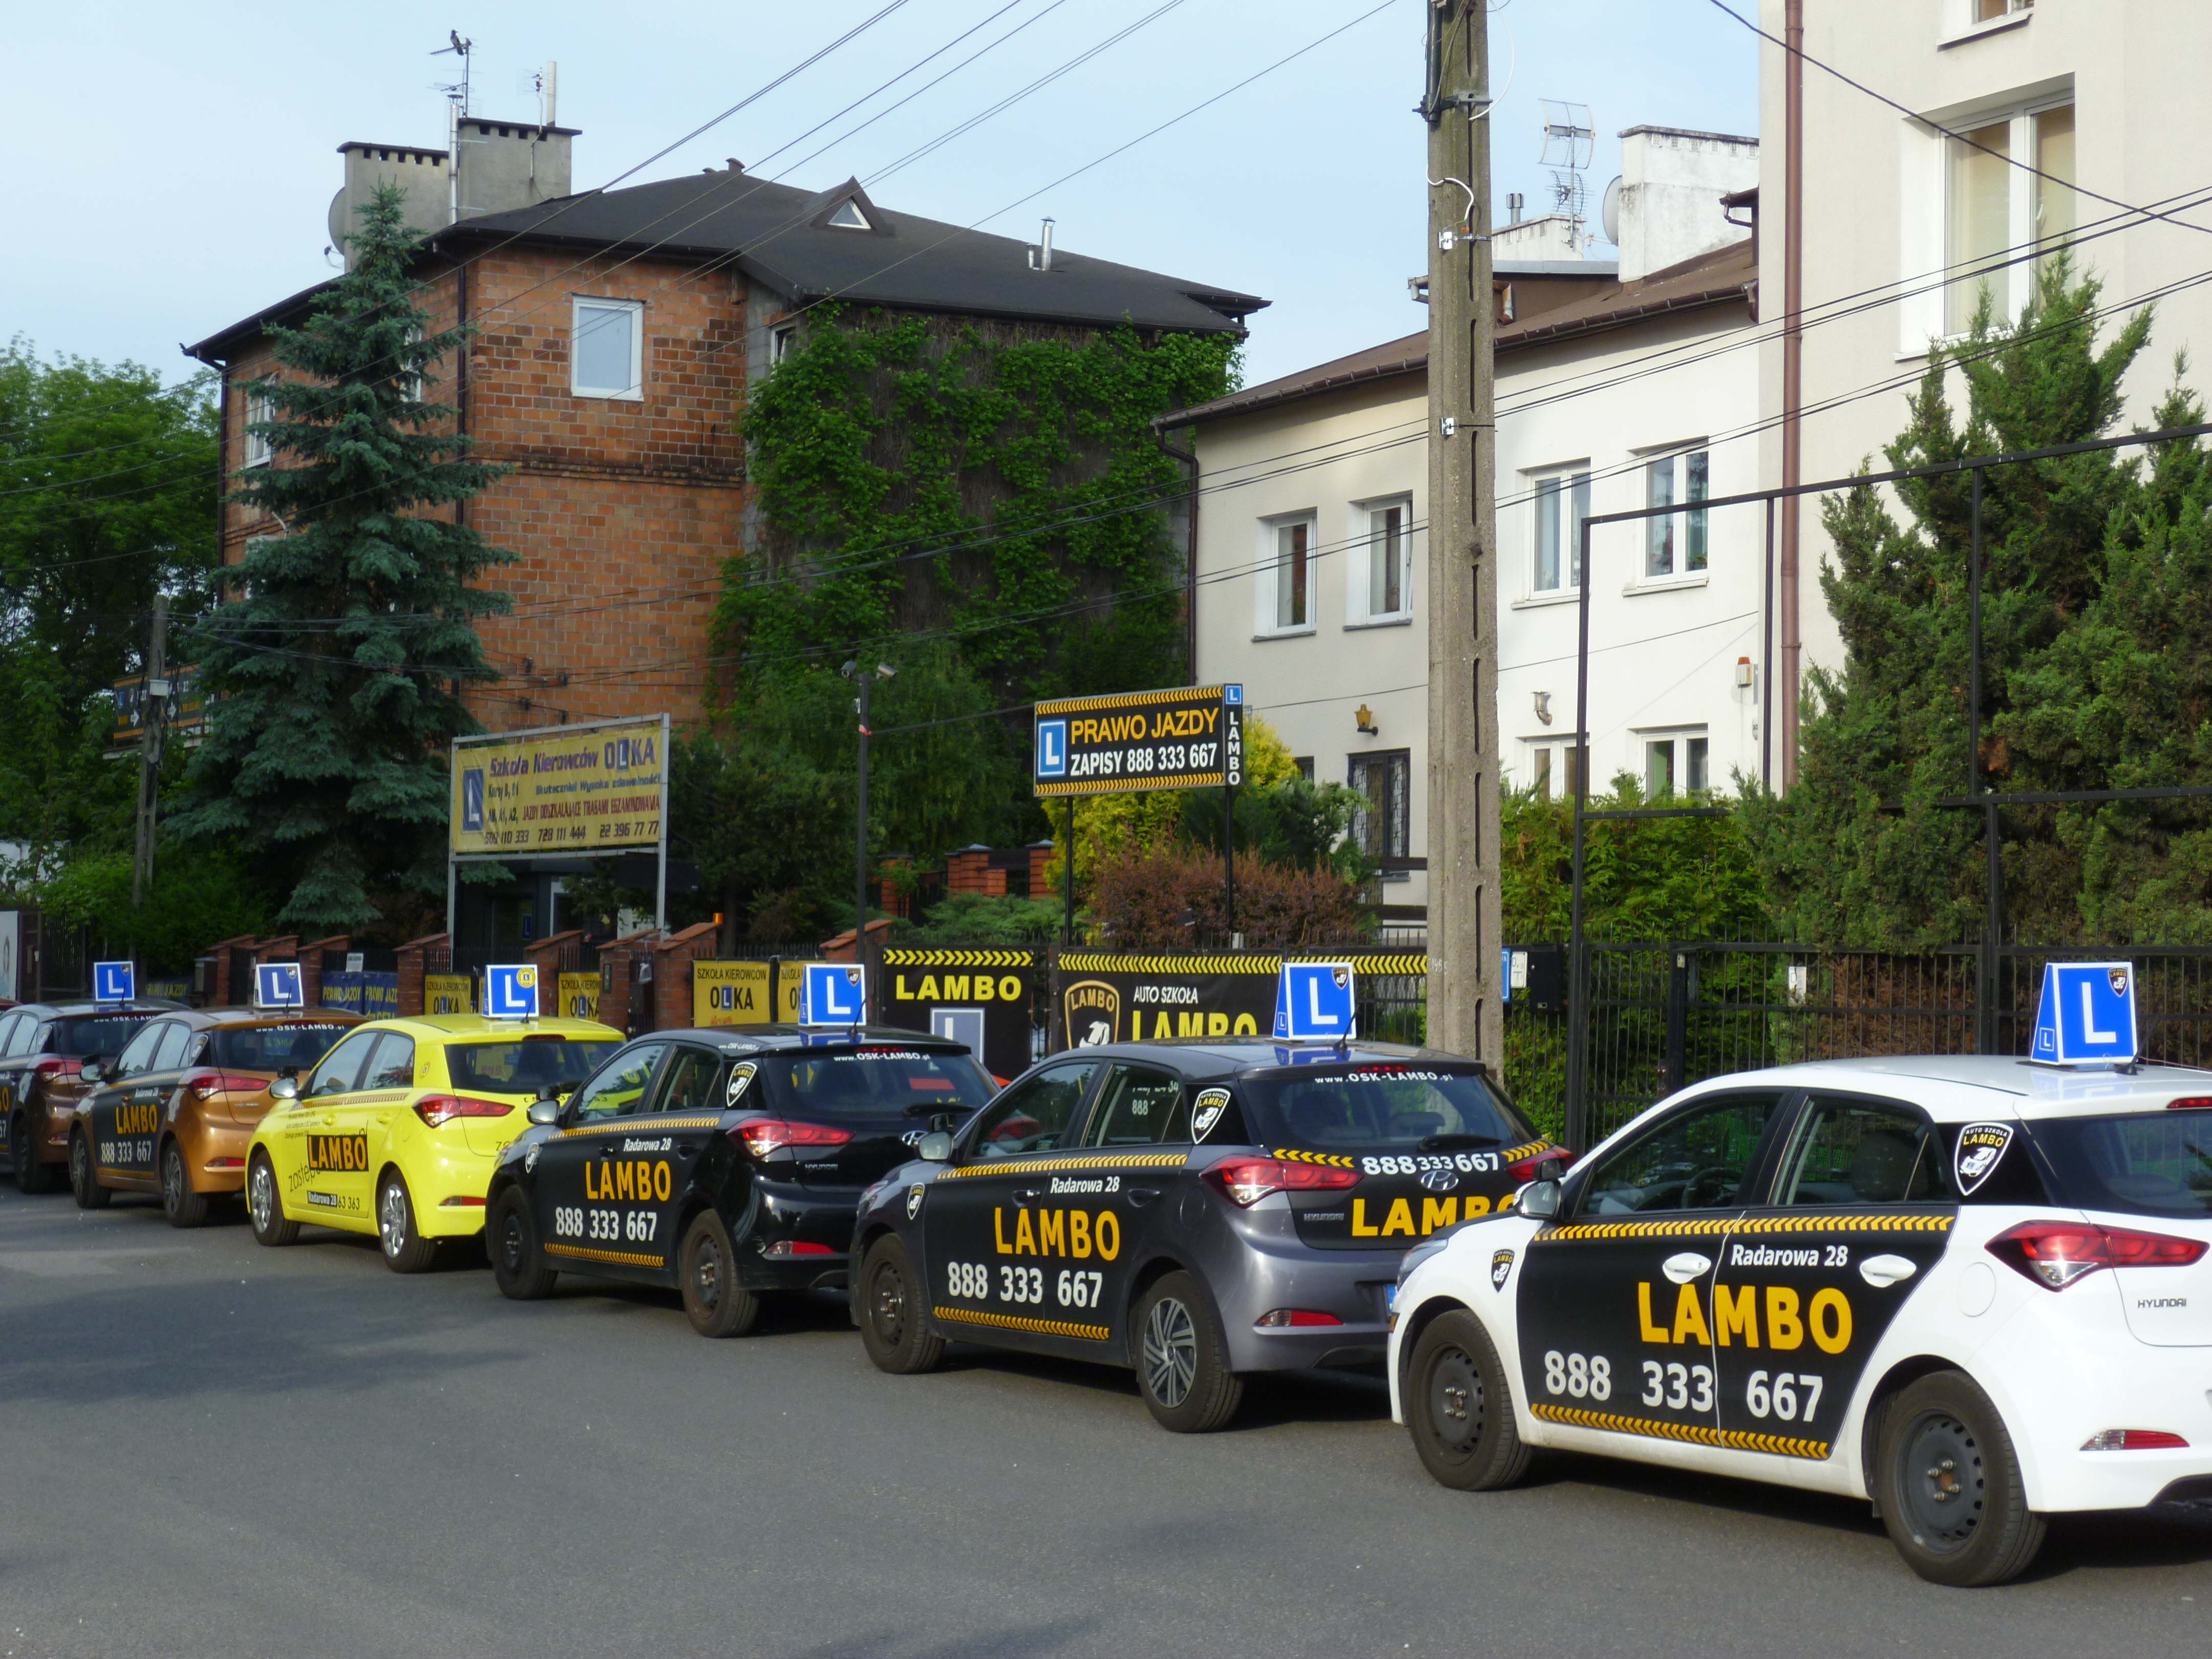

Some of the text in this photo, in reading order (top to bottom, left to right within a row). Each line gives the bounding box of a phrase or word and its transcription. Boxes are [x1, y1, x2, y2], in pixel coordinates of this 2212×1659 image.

[1229, 689, 1238, 701] L
[1071, 707, 1219, 745] PRAWO JAZDY
[534, 746, 599, 774] Kierowców
[1046, 732, 1059, 765] L
[1070, 742, 1217, 776] ZAPISY 888 333 667
[1228, 711, 1240, 785] LAMBO
[515, 830, 529, 843] 333
[570, 825, 586, 840] 444
[600, 823, 611, 838] 22
[634, 821, 645, 836] 77
[648, 820, 659, 835] 77
[108, 969, 124, 994] L
[272, 972, 291, 999] L
[725, 967, 766, 980] KIEROWCÓW
[505, 975, 526, 1007] L
[710, 986, 754, 1010] OLKA
[826, 975, 851, 1014] L
[896, 974, 1022, 1001] LAMBO
[1134, 986, 1199, 1004] AUTO SZKOŁA
[1071, 989, 1115, 1012] LAMBO
[1309, 977, 1338, 1025] L
[2082, 982, 2117, 1044] L
[834, 1052, 930, 1062] www.OSK-LAMBO.pl
[734, 1069, 752, 1078] LAMBO
[1314, 1072, 1453, 1084] www.OSK-LAMBO.pl
[1199, 1097, 1224, 1107] LAMBO
[116, 1104, 158, 1135] LAMBO
[101, 1140, 152, 1163] 888 333 667
[623, 1137, 672, 1152] Radarowa 28
[1963, 1133, 2005, 1147] LAMBO
[308, 1136, 366, 1171] LAMBO
[1362, 1152, 1499, 1175] 888 333 667
[585, 1160, 671, 1202] LAMBO
[1051, 1176, 1120, 1195] Radarowa 28
[308, 1192, 330, 1205] Radarowa
[348, 1197, 360, 1210] 363
[555, 1206, 657, 1241] 888 333 667
[1304, 1213, 1344, 1221] HYUNDAI
[994, 1207, 1120, 1261] LAMBO
[1494, 1254, 1513, 1264] LAMBO
[1731, 1244, 1848, 1267] Radarowa 28
[947, 1262, 1102, 1308] 888 333 667
[2137, 1298, 2187, 1309] HYUNDAI
[1637, 1281, 1853, 1354] LAMBO
[1544, 1350, 1824, 1423] 888 333 667
